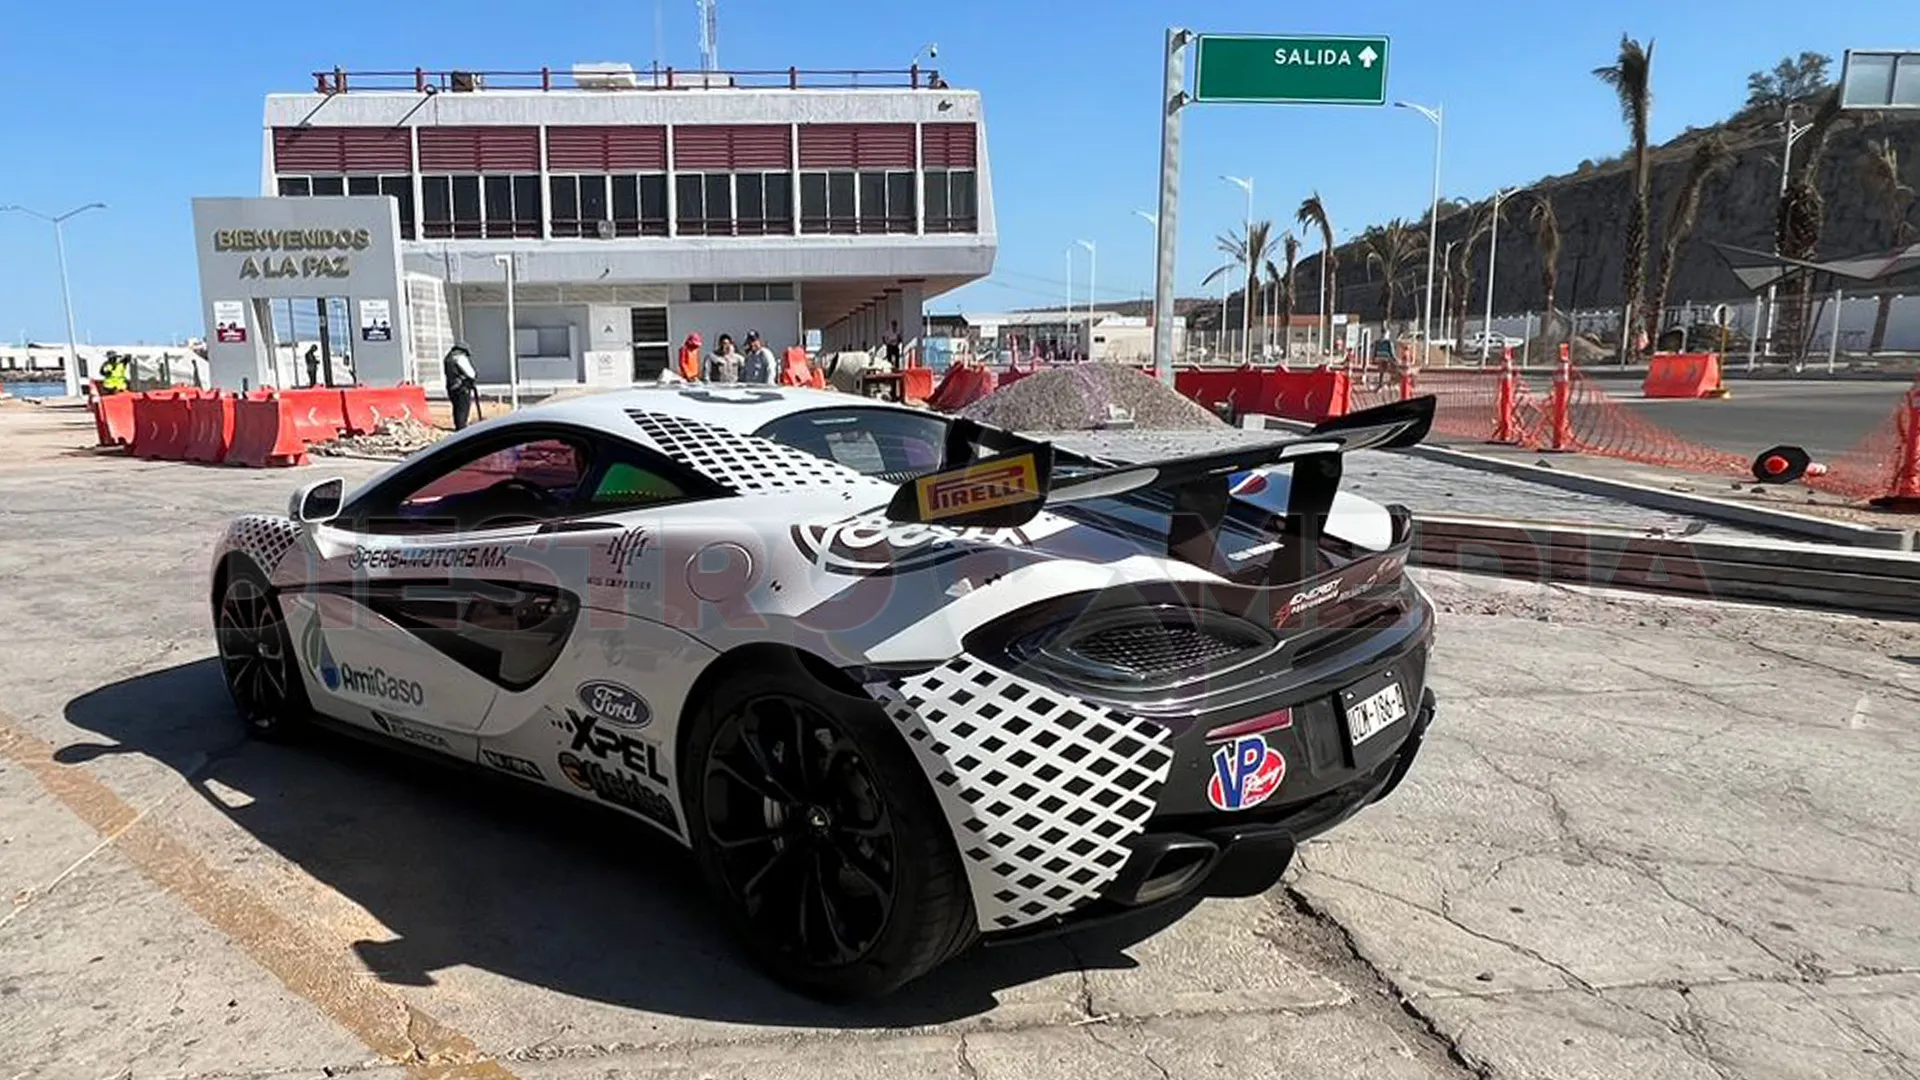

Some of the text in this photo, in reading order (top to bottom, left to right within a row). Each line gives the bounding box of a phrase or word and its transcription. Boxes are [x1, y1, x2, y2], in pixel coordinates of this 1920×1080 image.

[1274, 48, 1352, 65] SALIDA
[214, 227, 370, 251] BIENVENIDOS
[239, 255, 350, 279] A LA PAZ
[927, 465, 1025, 511] PIRELLI
[341, 662, 424, 705] AmiGaso
[592, 686, 638, 722] Ford
[565, 706, 669, 787] XPEL
[1212, 734, 1267, 809] VP
